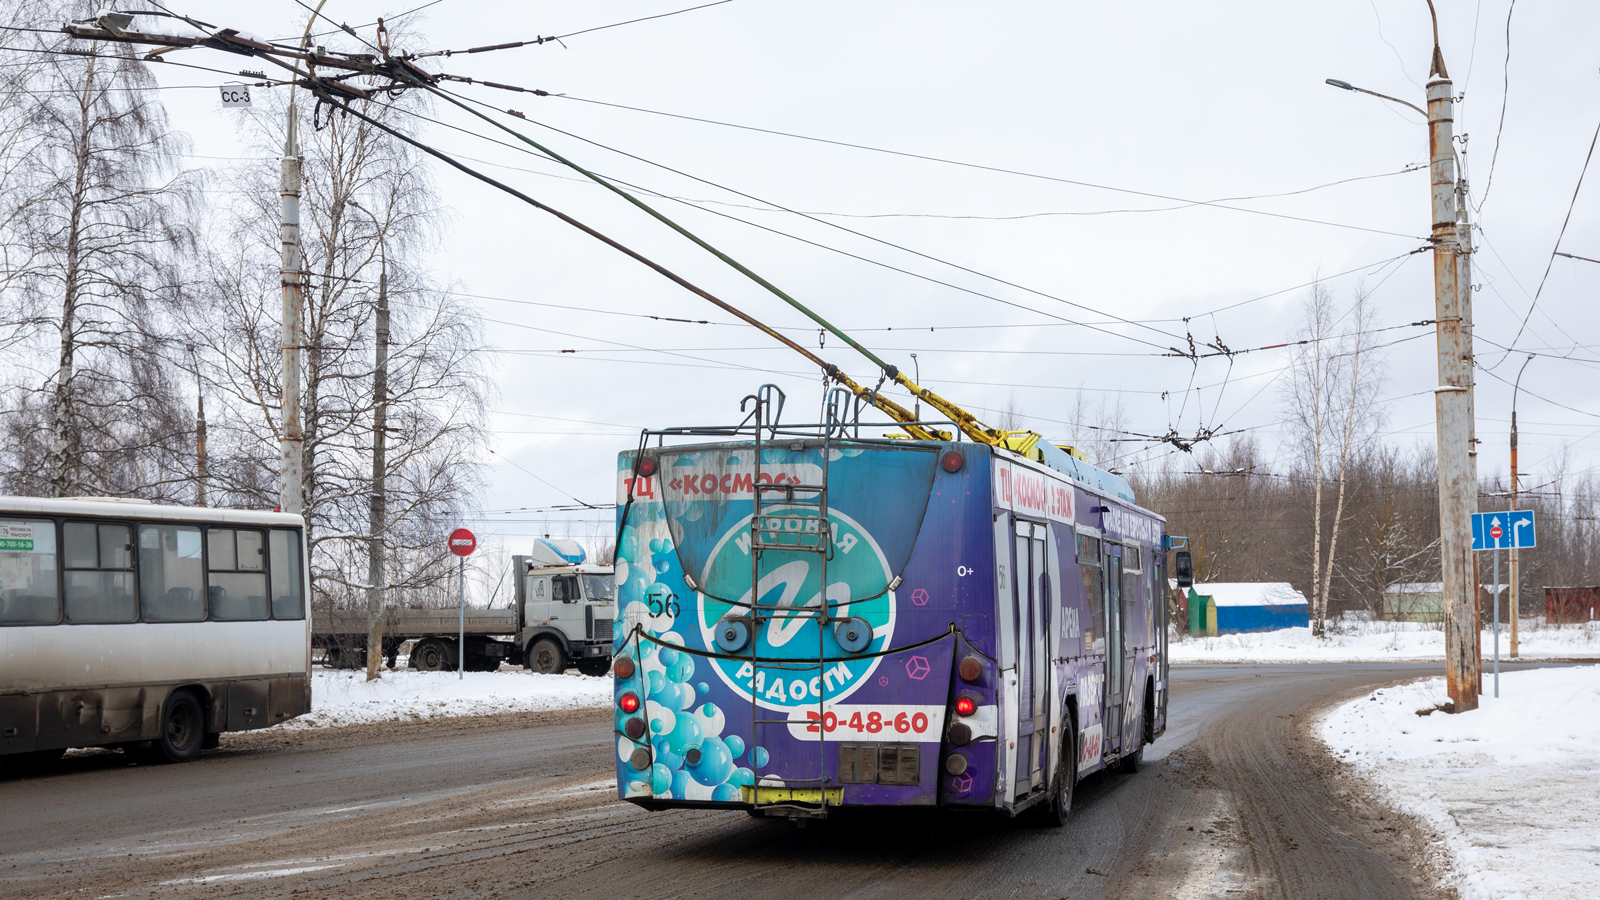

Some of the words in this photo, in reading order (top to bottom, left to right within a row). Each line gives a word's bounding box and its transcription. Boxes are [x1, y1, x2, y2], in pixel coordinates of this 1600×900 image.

[222, 91, 250, 103] СС-3
[624, 477, 653, 500] ТЦ
[1001, 467, 1011, 508] ТЦ
[647, 593, 681, 619] 56
[1062, 607, 1080, 638] АРЕНА
[735, 661, 853, 703] РАДОСТИ
[806, 711, 928, 733] 20-48-60
